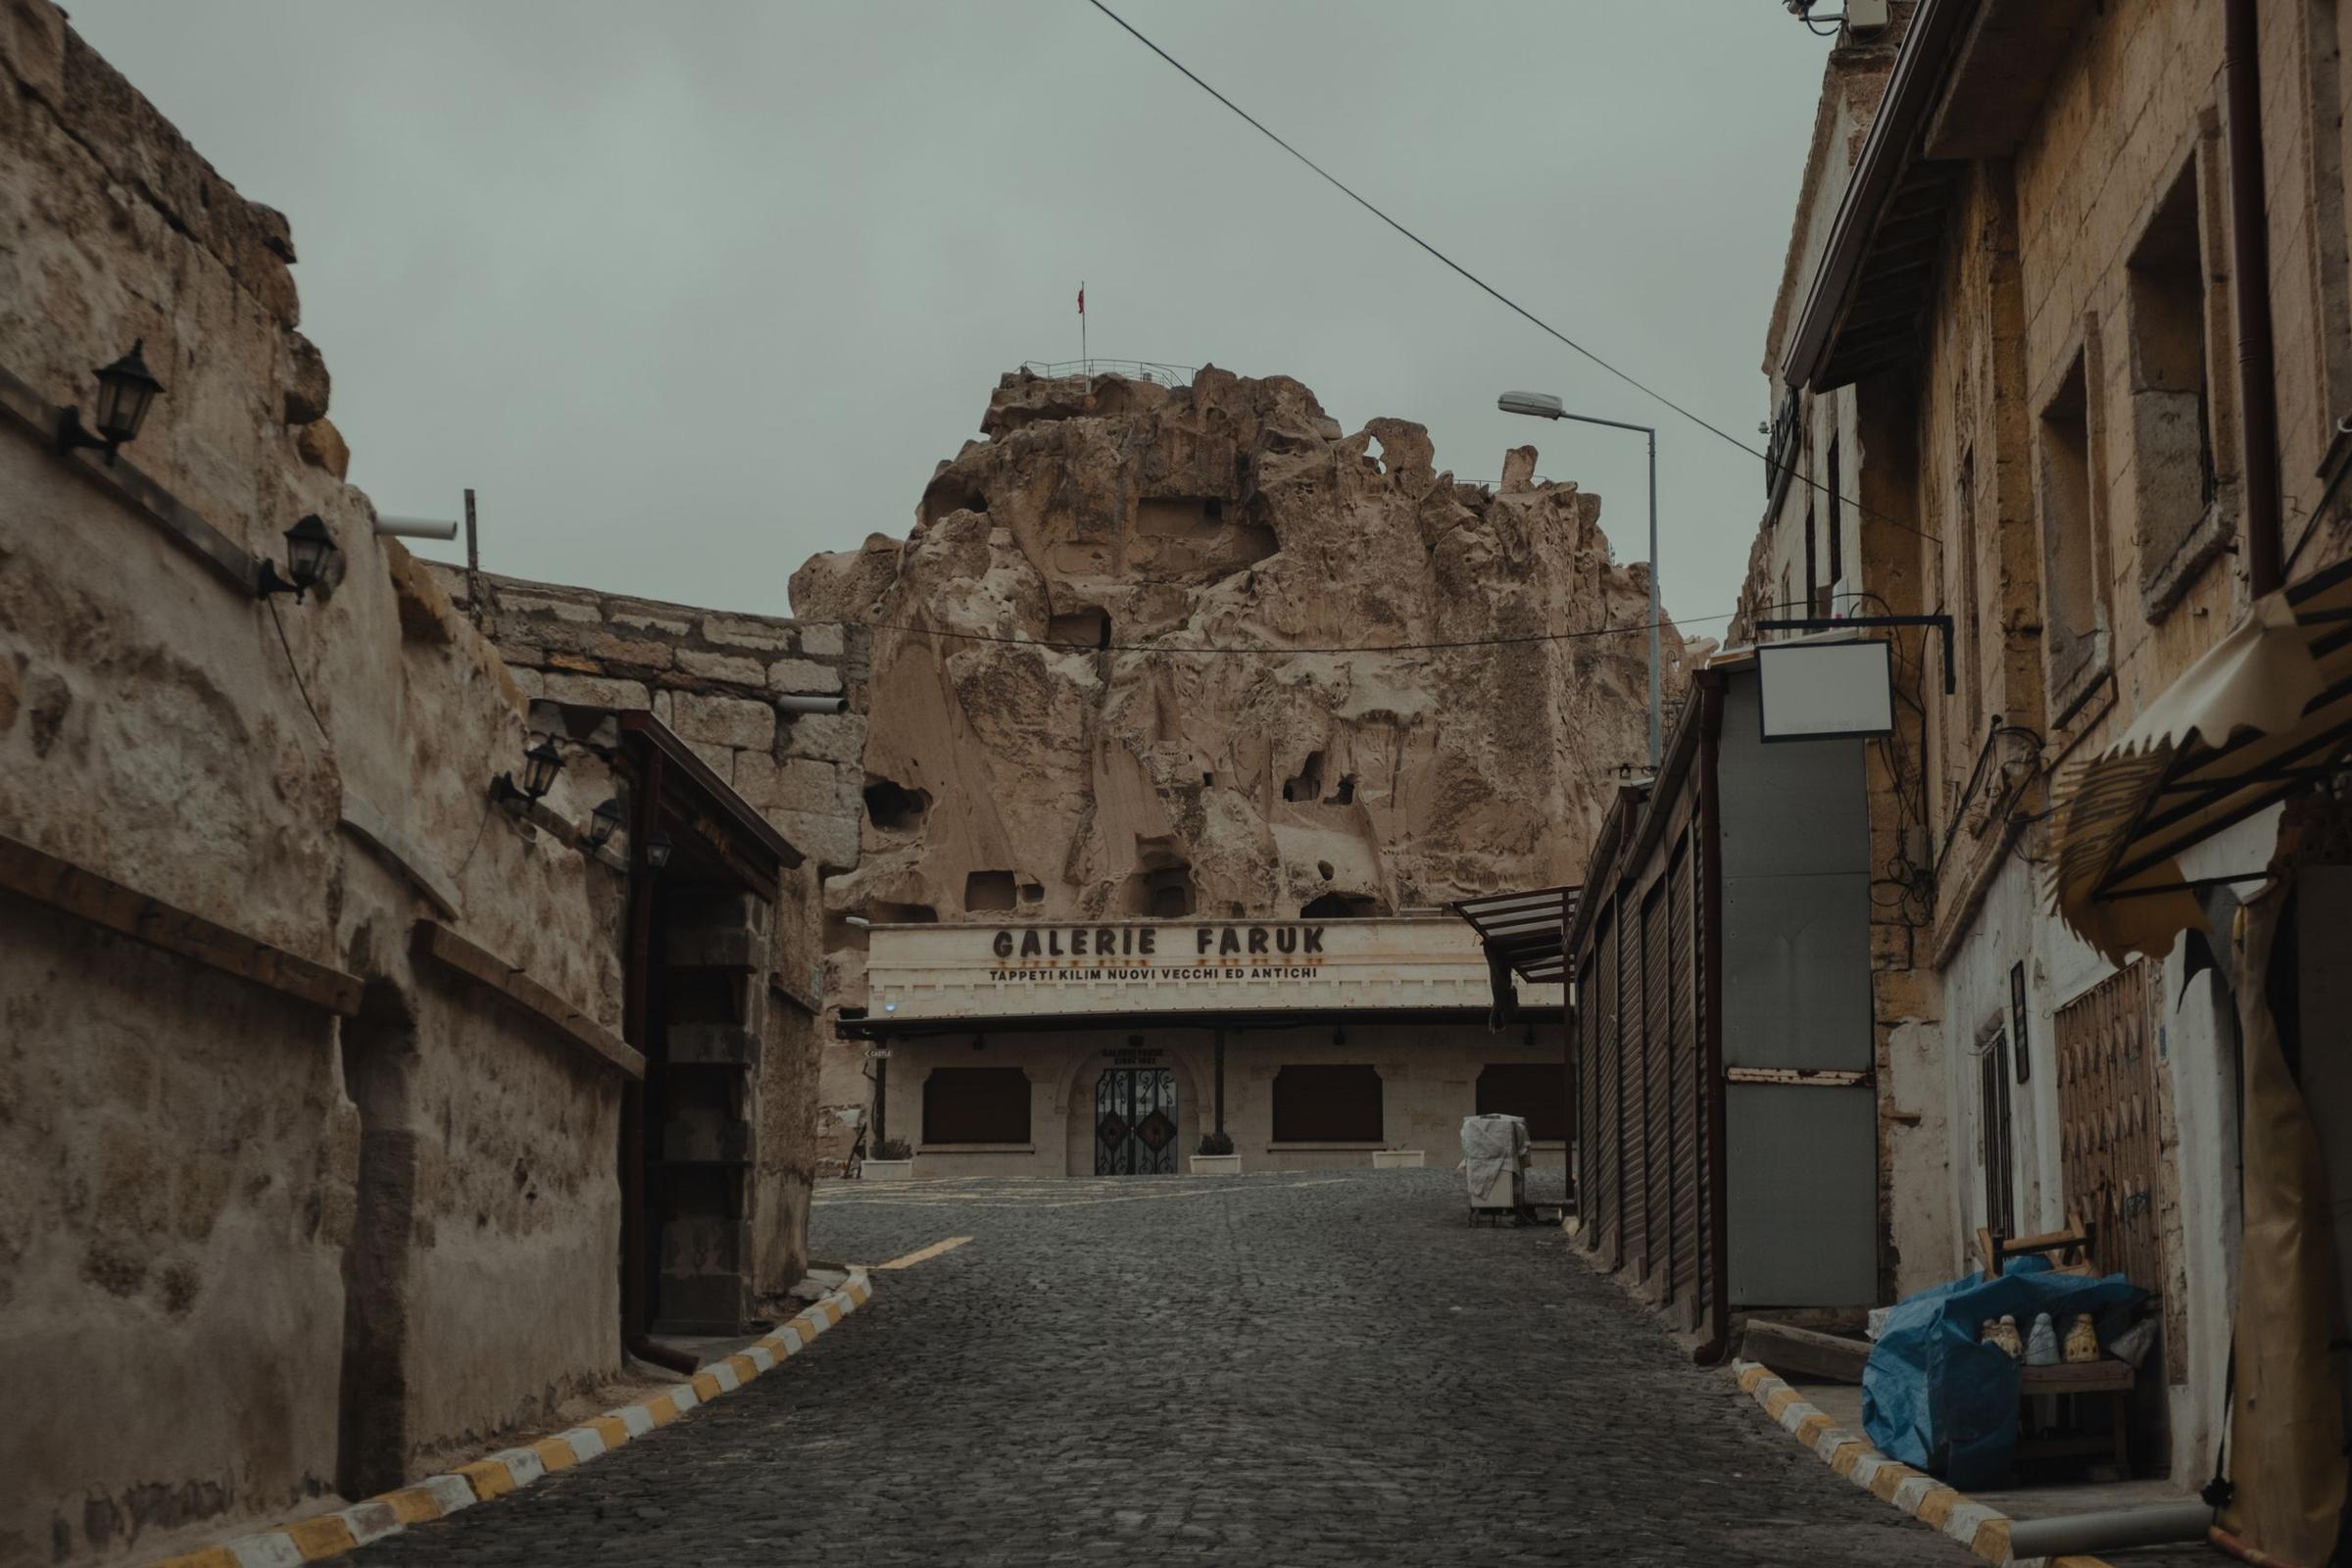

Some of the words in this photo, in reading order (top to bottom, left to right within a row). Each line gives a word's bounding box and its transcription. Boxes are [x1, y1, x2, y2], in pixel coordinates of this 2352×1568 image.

[992, 928, 1156, 958] GALERIE
[1197, 926, 1325, 956] FARUK
[989, 970, 1054, 981] TAPPETI
[1058, 969, 1102, 980] KILIM
[1107, 969, 1155, 980] NUOVI
[1161, 968, 1218, 979] VECCHI
[1225, 968, 1245, 979] ED
[1251, 967, 1317, 979] ANTICHI
